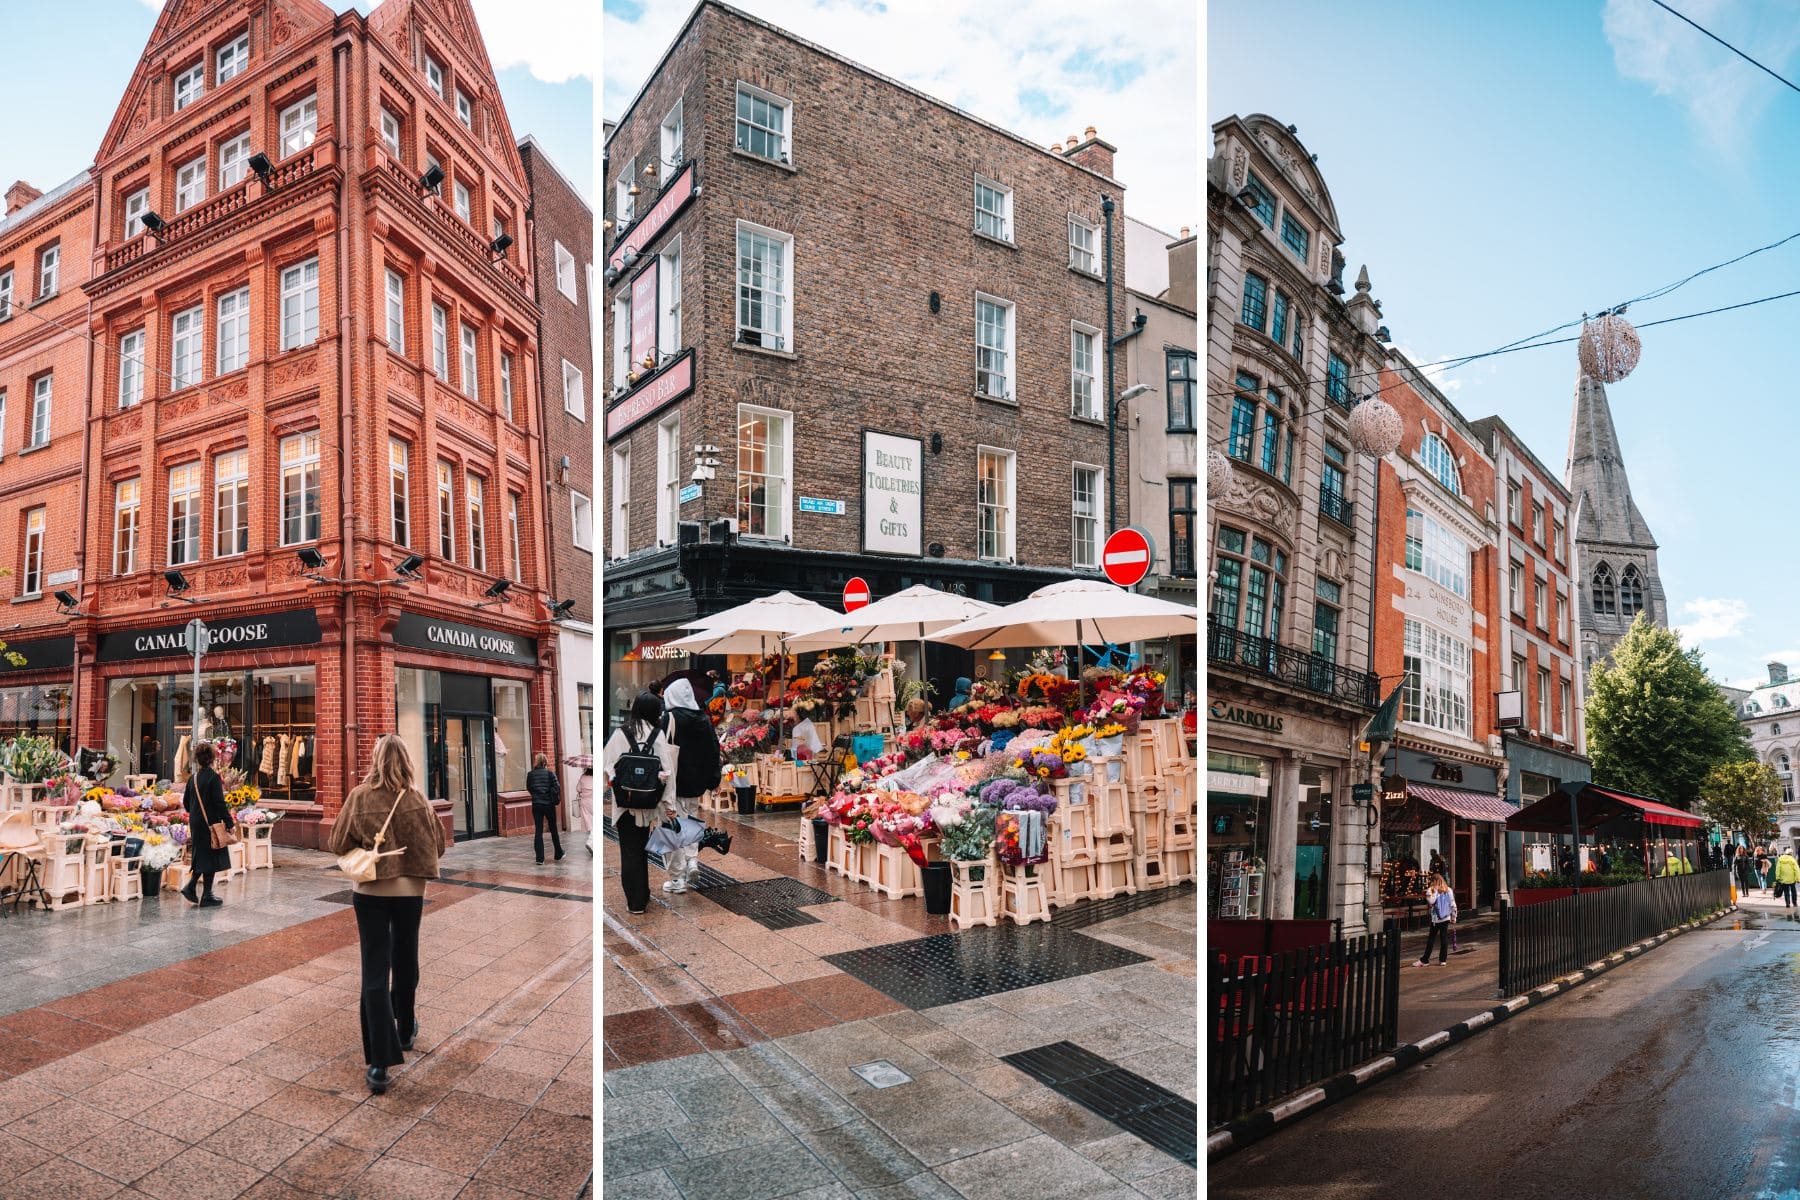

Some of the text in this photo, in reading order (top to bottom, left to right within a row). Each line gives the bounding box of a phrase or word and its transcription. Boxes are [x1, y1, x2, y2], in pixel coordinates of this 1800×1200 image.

[618, 374, 676, 426] ESPRESSO BAR
[876, 450, 912, 471] BEAUTY
[868, 472, 920, 495] TOILETRIES
[889, 497, 898, 514] &
[880, 519, 908, 537] GIFTS
[1437, 608, 1458, 628] HOUSE
[135, 623, 268, 651] CANAD GOOSE
[427, 625, 515, 655] CANADA GOOSE
[641, 646, 654, 660] M&S
[655, 646, 678, 659] COFFEE
[1210, 700, 1284, 732] CARROLLS
[1385, 791, 1404, 800] Zizzi
